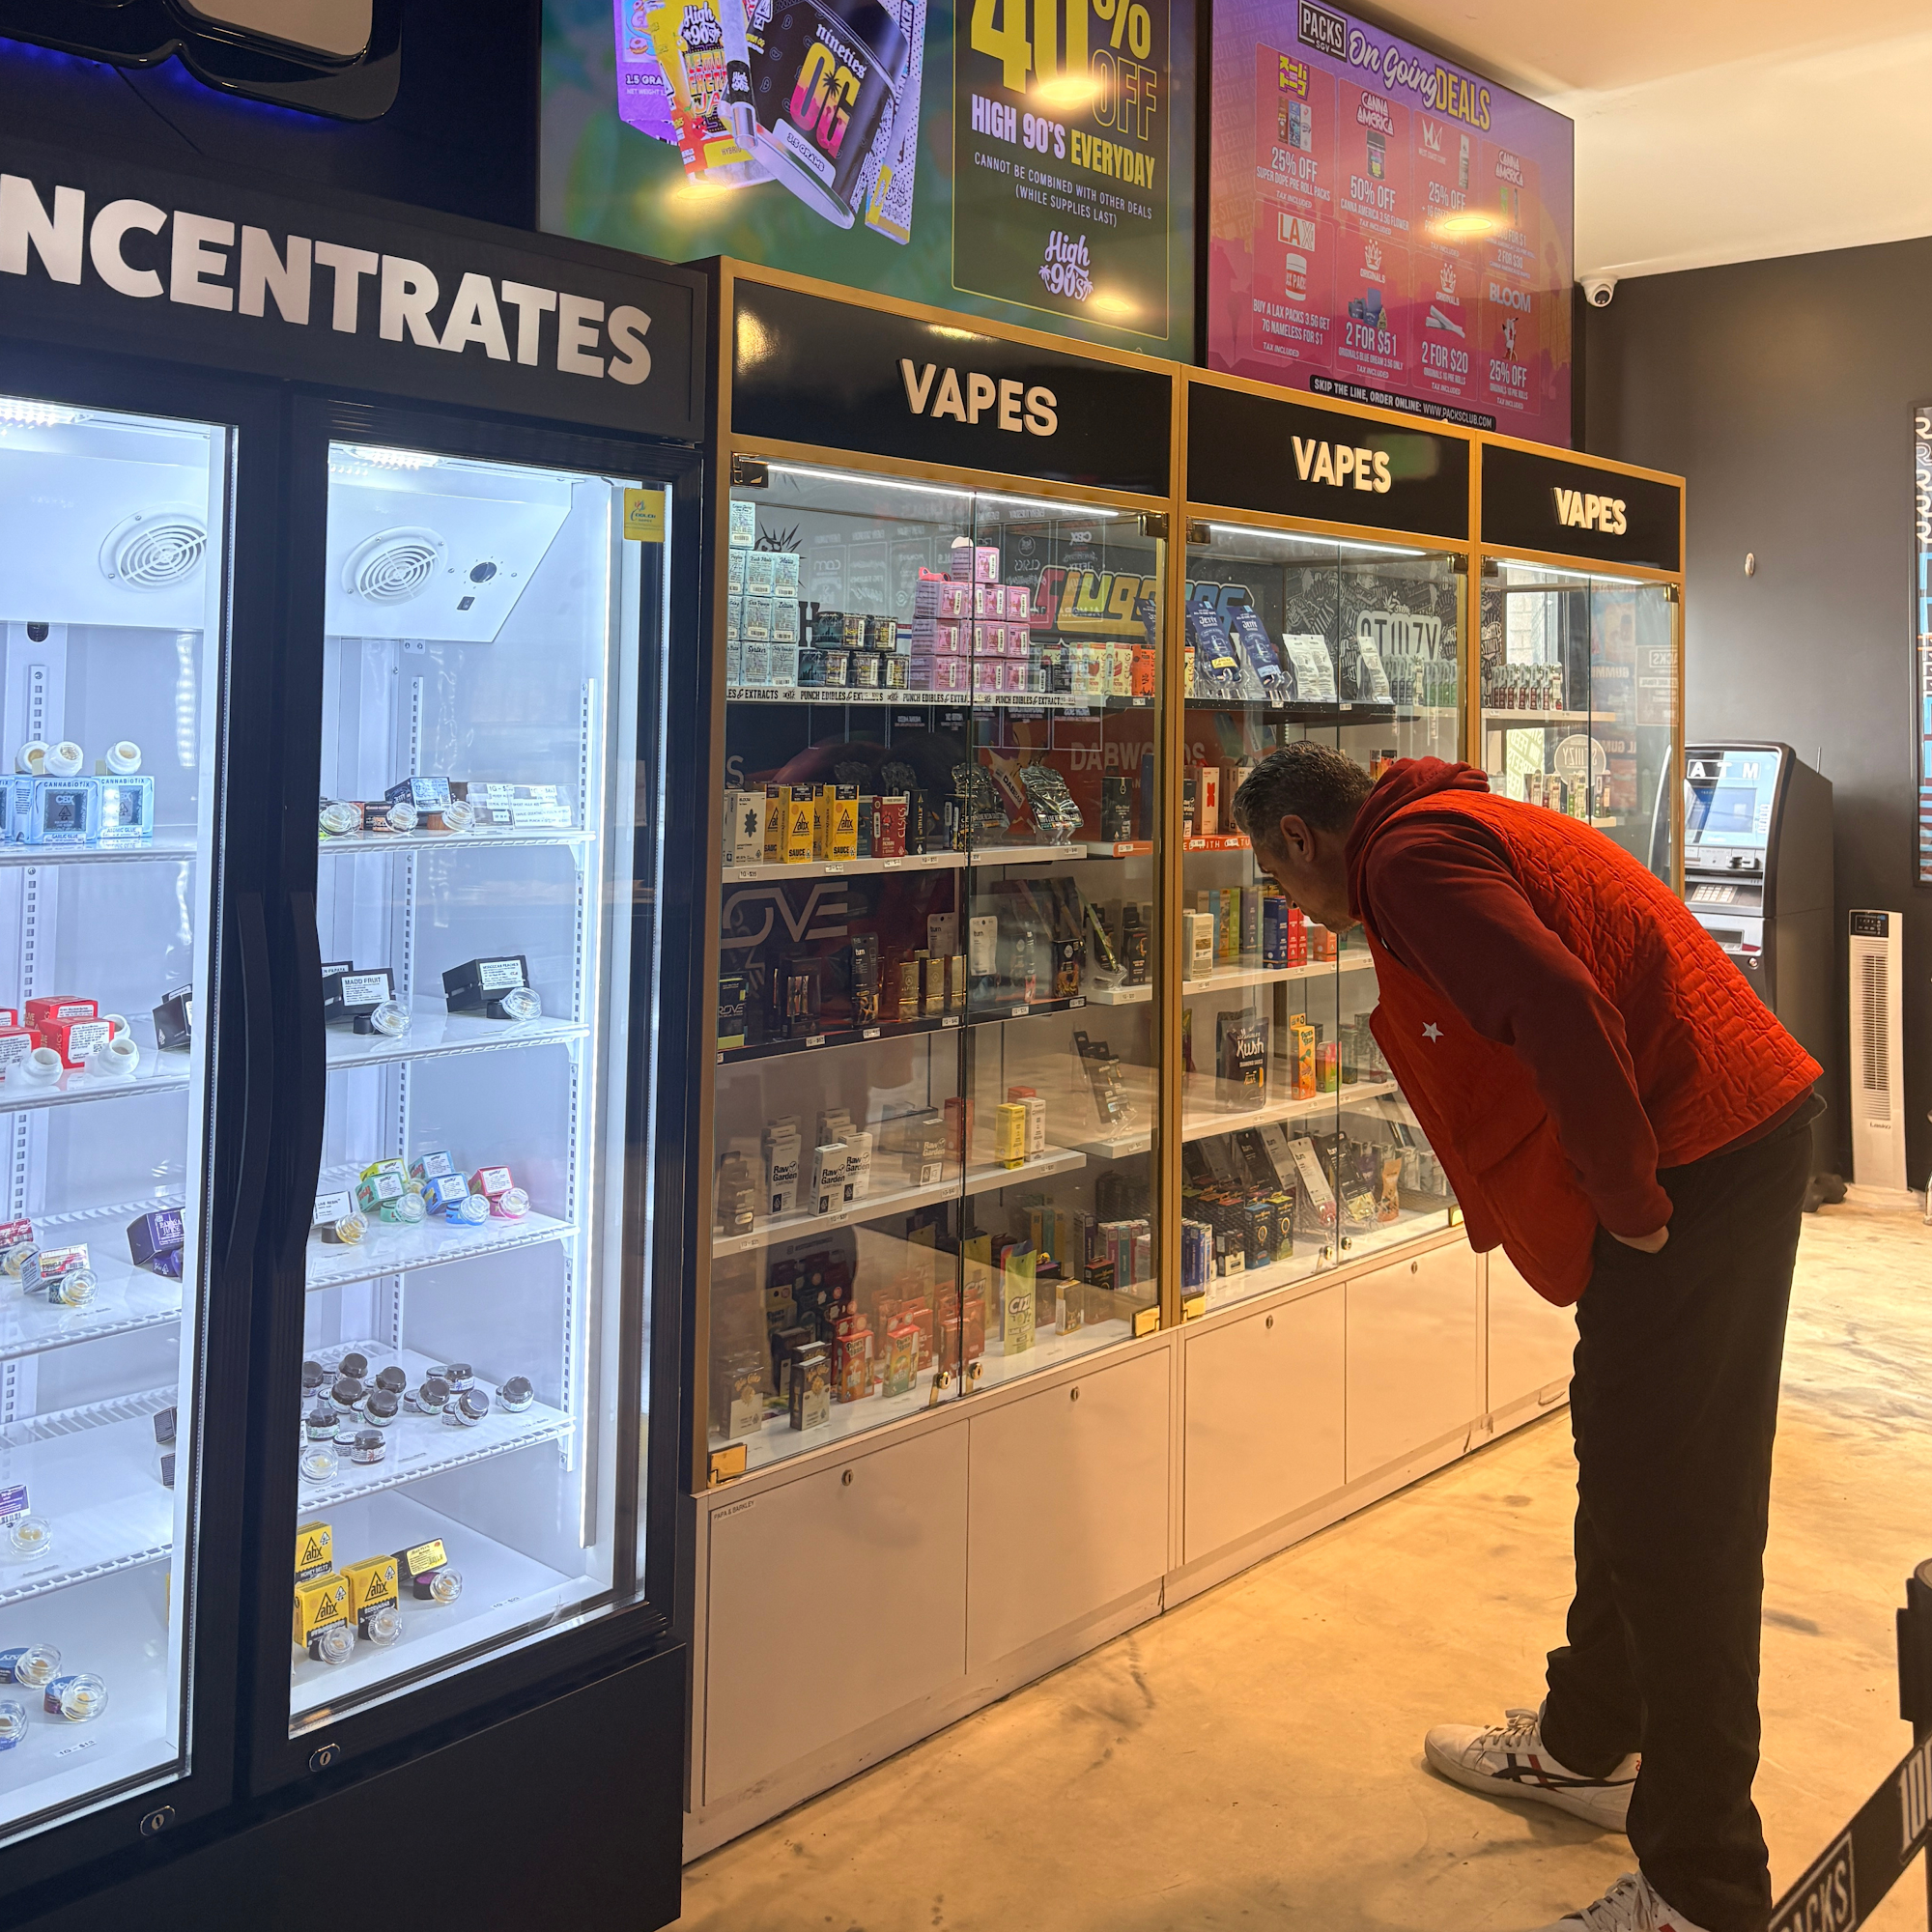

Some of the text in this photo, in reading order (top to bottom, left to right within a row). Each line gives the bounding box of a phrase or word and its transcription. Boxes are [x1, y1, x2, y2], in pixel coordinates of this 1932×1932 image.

[1303, 8, 1345, 47] PACKS
[815, 23, 867, 79] nineties
[1315, 40, 1331, 53] SGV
[1349, 30, 1492, 131] On Going DEALS
[790, 42, 862, 159] OG
[1092, 48, 1157, 141] OFF
[1361, 92, 1389, 116] CANNA
[1356, 106, 1394, 136] AMERICA
[972, 94, 1156, 190] HIGH 90'S EVERYDAY
[1271, 147, 1318, 183] 25% OFF
[1498, 151, 1520, 171] CANNA
[1256, 166, 1331, 202] SUPER DOPE PRE ROLL PACKS
[1496, 162, 1524, 186] AMERICA
[974, 152, 1152, 220] CANNOT BE COMBINED WITH OTHER DEALS
[1350, 175, 1396, 212] 50% OFF
[1015, 184, 1118, 228] (WHILE SUPPLIES LAST)
[1276, 190, 1313, 209] TAX INCLUDED
[1429, 181, 1466, 213] 25% OFF
[1341, 198, 1409, 231] CANNA AMERICA 3.5G FLOWER
[1359, 218, 1392, 236] TAX INCLUDED
[1044, 230, 1091, 272] High
[1431, 242, 1460, 258] TAX INCLUDED
[1497, 249, 1522, 269] 2 FOR $30
[1360, 269, 1385, 284] ORIGINALS
[1490, 282, 1531, 313] BLOOM
[1253, 298, 1331, 330] BUY A LAX PACKS 3.5G GET
[1262, 319, 1323, 345] 7G NAMELESS FOR $1
[1346, 322, 1397, 356] 2 FOR $51
[1263, 342, 1299, 357] TAX INCLUDED
[1422, 341, 1468, 374] 2 FOR $20
[1360, 352, 1369, 362] BLUE
[1370, 353, 1383, 365] DREAM
[1393, 359, 1404, 371] ONLY
[1356, 365, 1389, 379] TAX INCLUDED
[1490, 359, 1527, 387] 25% OFF
[900, 356, 1059, 439] VAPES
[1439, 384, 1461, 396] INCLUDED
[1314, 379, 1492, 429] SKIP THE LINE, ORDER ONLINE: WWW.PACKSCLUB.COM
[1291, 435, 1391, 495] VAPES
[1553, 487, 1627, 536] VAPES
[744, 689, 779, 700] EXTRACTS
[801, 690, 846, 701] PUNCH EDIBLES
[903, 693, 945, 703] PUNCH EDIBLES
[996, 695, 1033, 706] PUNCH EDIBLES
[796, 819, 810, 832] abx
[840, 818, 853, 831] abx
[788, 849, 806, 858] SAUCE
[834, 846, 850, 855] SAUCE
[856, 948, 866, 956] turn
[1236, 1037, 1264, 1060] Kush
[923, 1142, 938, 1151] Raw
[923, 1148, 946, 1157] Garden
[773, 1165, 789, 1175] Raw
[846, 1156, 862, 1165] Raw
[846, 1163, 869, 1172] Garden
[773, 1172, 797, 1181] Garden
[821, 1175, 845, 1184] Garden
[822, 1168, 838, 1178] Raw
[714, 1510, 727, 1520] PAPA
[732, 1500, 754, 1514] BARKLEY
[306, 1546, 323, 1561] abx
[371, 1580, 388, 1597] abx
[321, 1602, 338, 1618] abx
